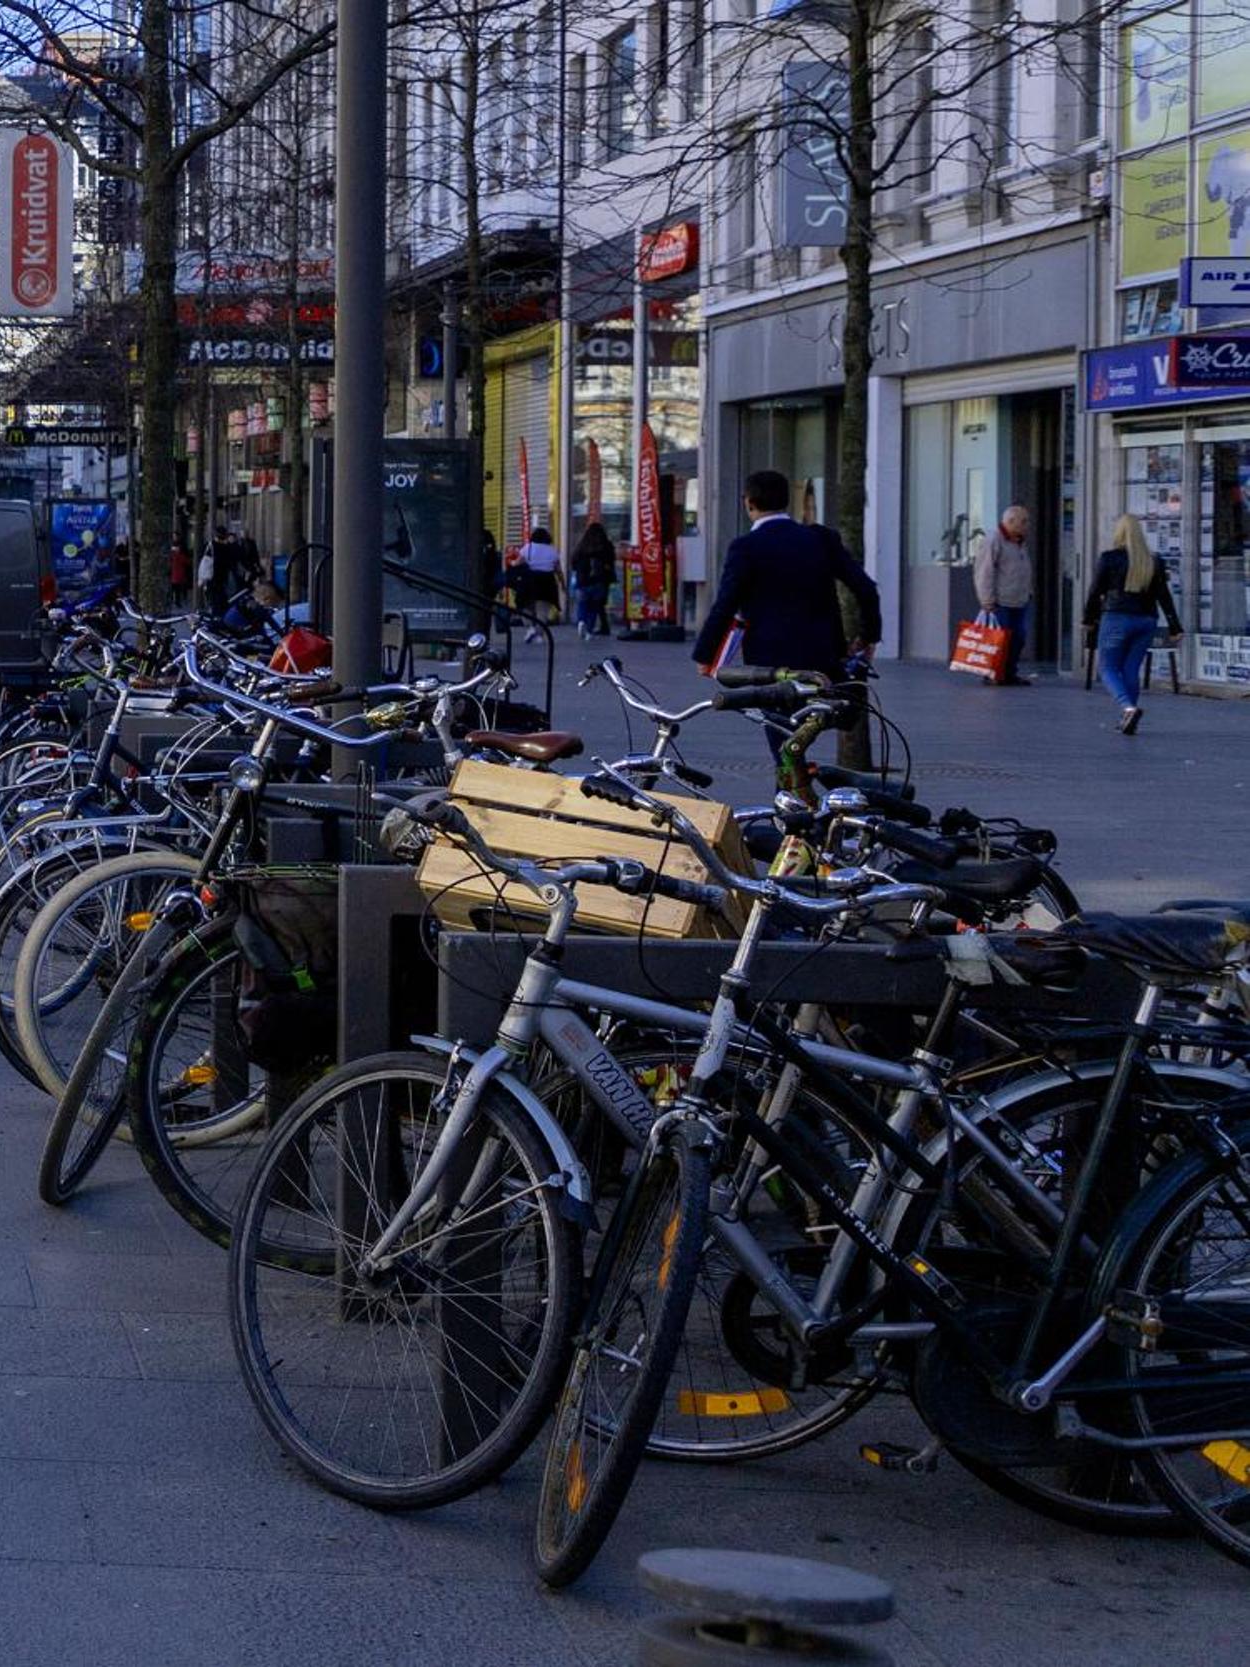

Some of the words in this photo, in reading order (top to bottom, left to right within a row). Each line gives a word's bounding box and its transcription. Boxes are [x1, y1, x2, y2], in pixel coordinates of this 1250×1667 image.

[22, 148, 50, 265] Kruidvat
[1201, 271, 1237, 281] AIR
[384, 473, 418, 488] JOY
[585, 1051, 635, 1105] VAN
